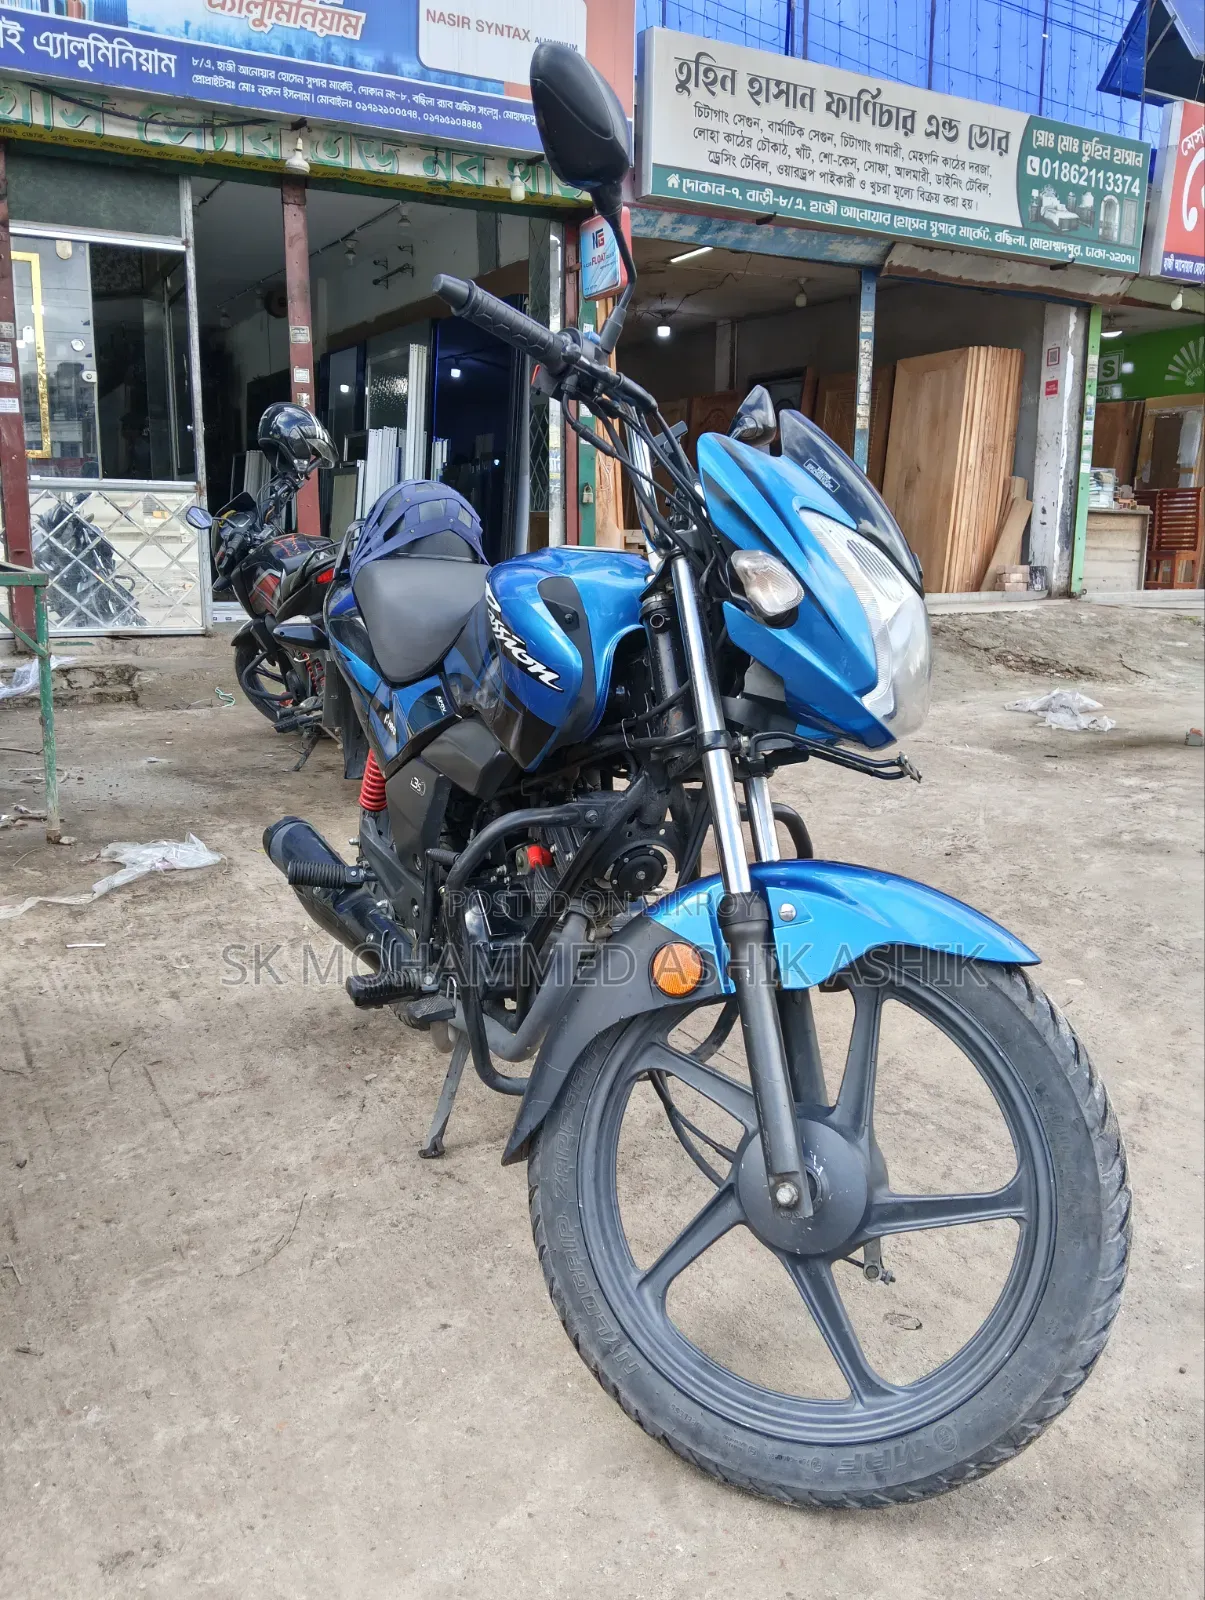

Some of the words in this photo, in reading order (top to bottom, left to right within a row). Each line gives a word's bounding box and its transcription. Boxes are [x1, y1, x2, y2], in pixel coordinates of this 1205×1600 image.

[426, 8, 471, 30] NASIR
[475, 19, 531, 42] SYNTAX
[33, 31, 177, 78] এ্যালুমিনিয়াম
[217, 59, 236, 73] হাজী
[237, 65, 276, 80] আনোয়ার
[277, 70, 304, 85] হোসেন
[305, 76, 327, 89] সুপার
[358, 85, 383, 98] দোকান
[412, 92, 435, 108] বছিলা
[455, 100, 477, 115] অফিস
[502, 110, 537, 127] মোহাম্মদপু
[674, 51, 737, 97] তুহিন
[746, 72, 816, 113] হাসান
[925, 114, 960, 143] এন্ড
[968, 123, 1011, 156] ডোর
[693, 101, 729, 124] চিটাগাং
[733, 113, 763, 134] সেগুন,
[767, 119, 805, 139] বার্মাটিক
[808, 128, 837, 149] সেগুন,
[840, 131, 871, 153] চিটাগাং
[875, 142, 904, 162] গামারী,
[908, 149, 939, 167] মেহগনি
[941, 153, 966, 171] কাঠের
[969, 161, 992, 179] দরজা,
[693, 126, 720, 144] লোহা
[723, 130, 753, 149] কাঠের
[757, 136, 791, 160] চৌকাঠ,
[863, 159, 890, 178] সোফা,
[894, 165, 931, 186] আলমারী,
[935, 173, 963, 191] ডাইনিং
[965, 178, 991, 198] টেবিল,
[1082, 136, 1111, 163] তুহিন
[1113, 147, 1144, 168] হাসান
[708, 148, 737, 168] ড্রেসিং
[740, 153, 772, 176] টেবিল,
[819, 170, 855, 189] পাইকারী
[859, 179, 866, 190] ও
[870, 180, 891, 196] খুচরা
[893, 185, 914, 201] মূল্যে
[942, 196, 959, 208] করা
[1041, 157, 1141, 197] 01862113374
[809, 199, 838, 216] হাজী
[840, 205, 891, 226] আনোয়ার
[893, 214, 927, 232] হোসেন
[929, 220, 957, 237] সুপার
